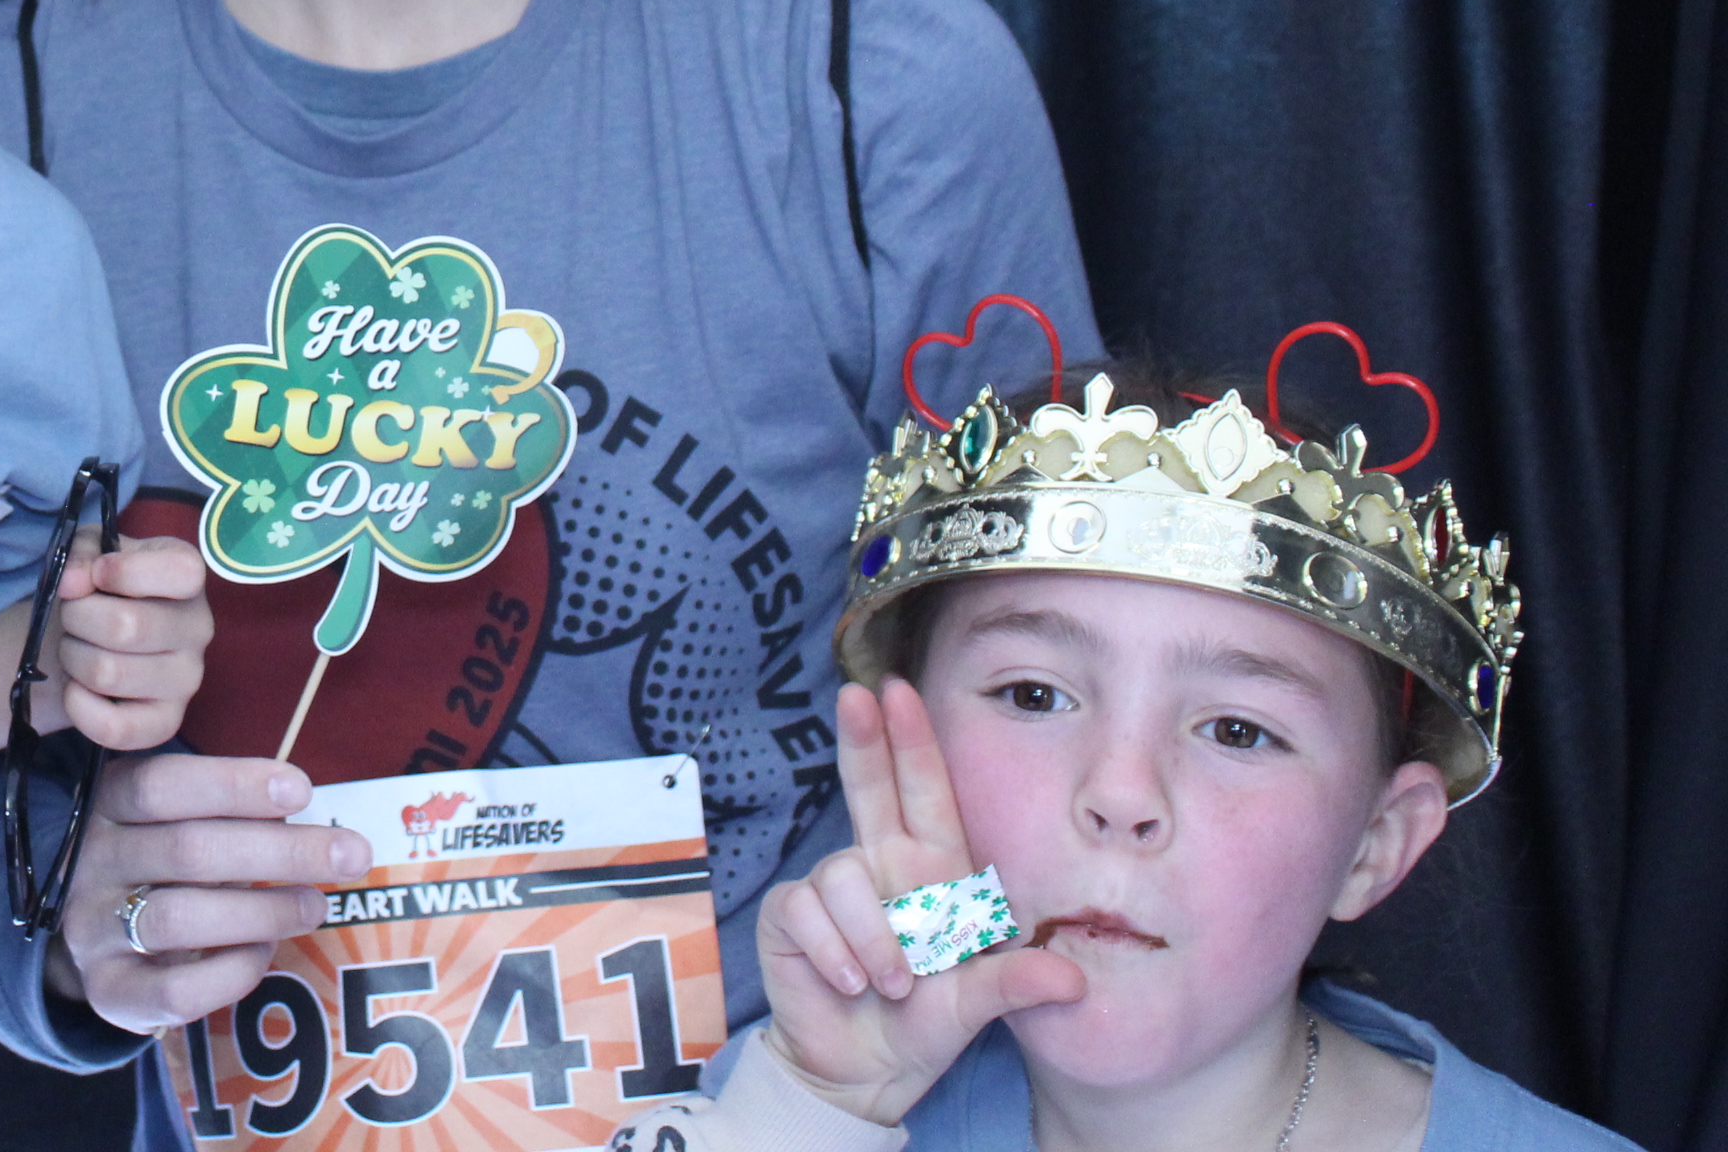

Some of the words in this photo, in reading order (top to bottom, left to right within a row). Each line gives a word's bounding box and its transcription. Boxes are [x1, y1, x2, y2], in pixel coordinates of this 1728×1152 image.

[303, 305, 460, 359] Have
[368, 359, 401, 390] a
[223, 378, 540, 469] LUCKY
[555, 369, 662, 455] OF
[291, 460, 429, 532] Day
[446, 590, 529, 728] 2025
[442, 820, 565, 852] LIFESAVERS
[327, 887, 408, 924] EART
[413, 877, 523, 914] WALK
[184, 934, 705, 1140] 19541
